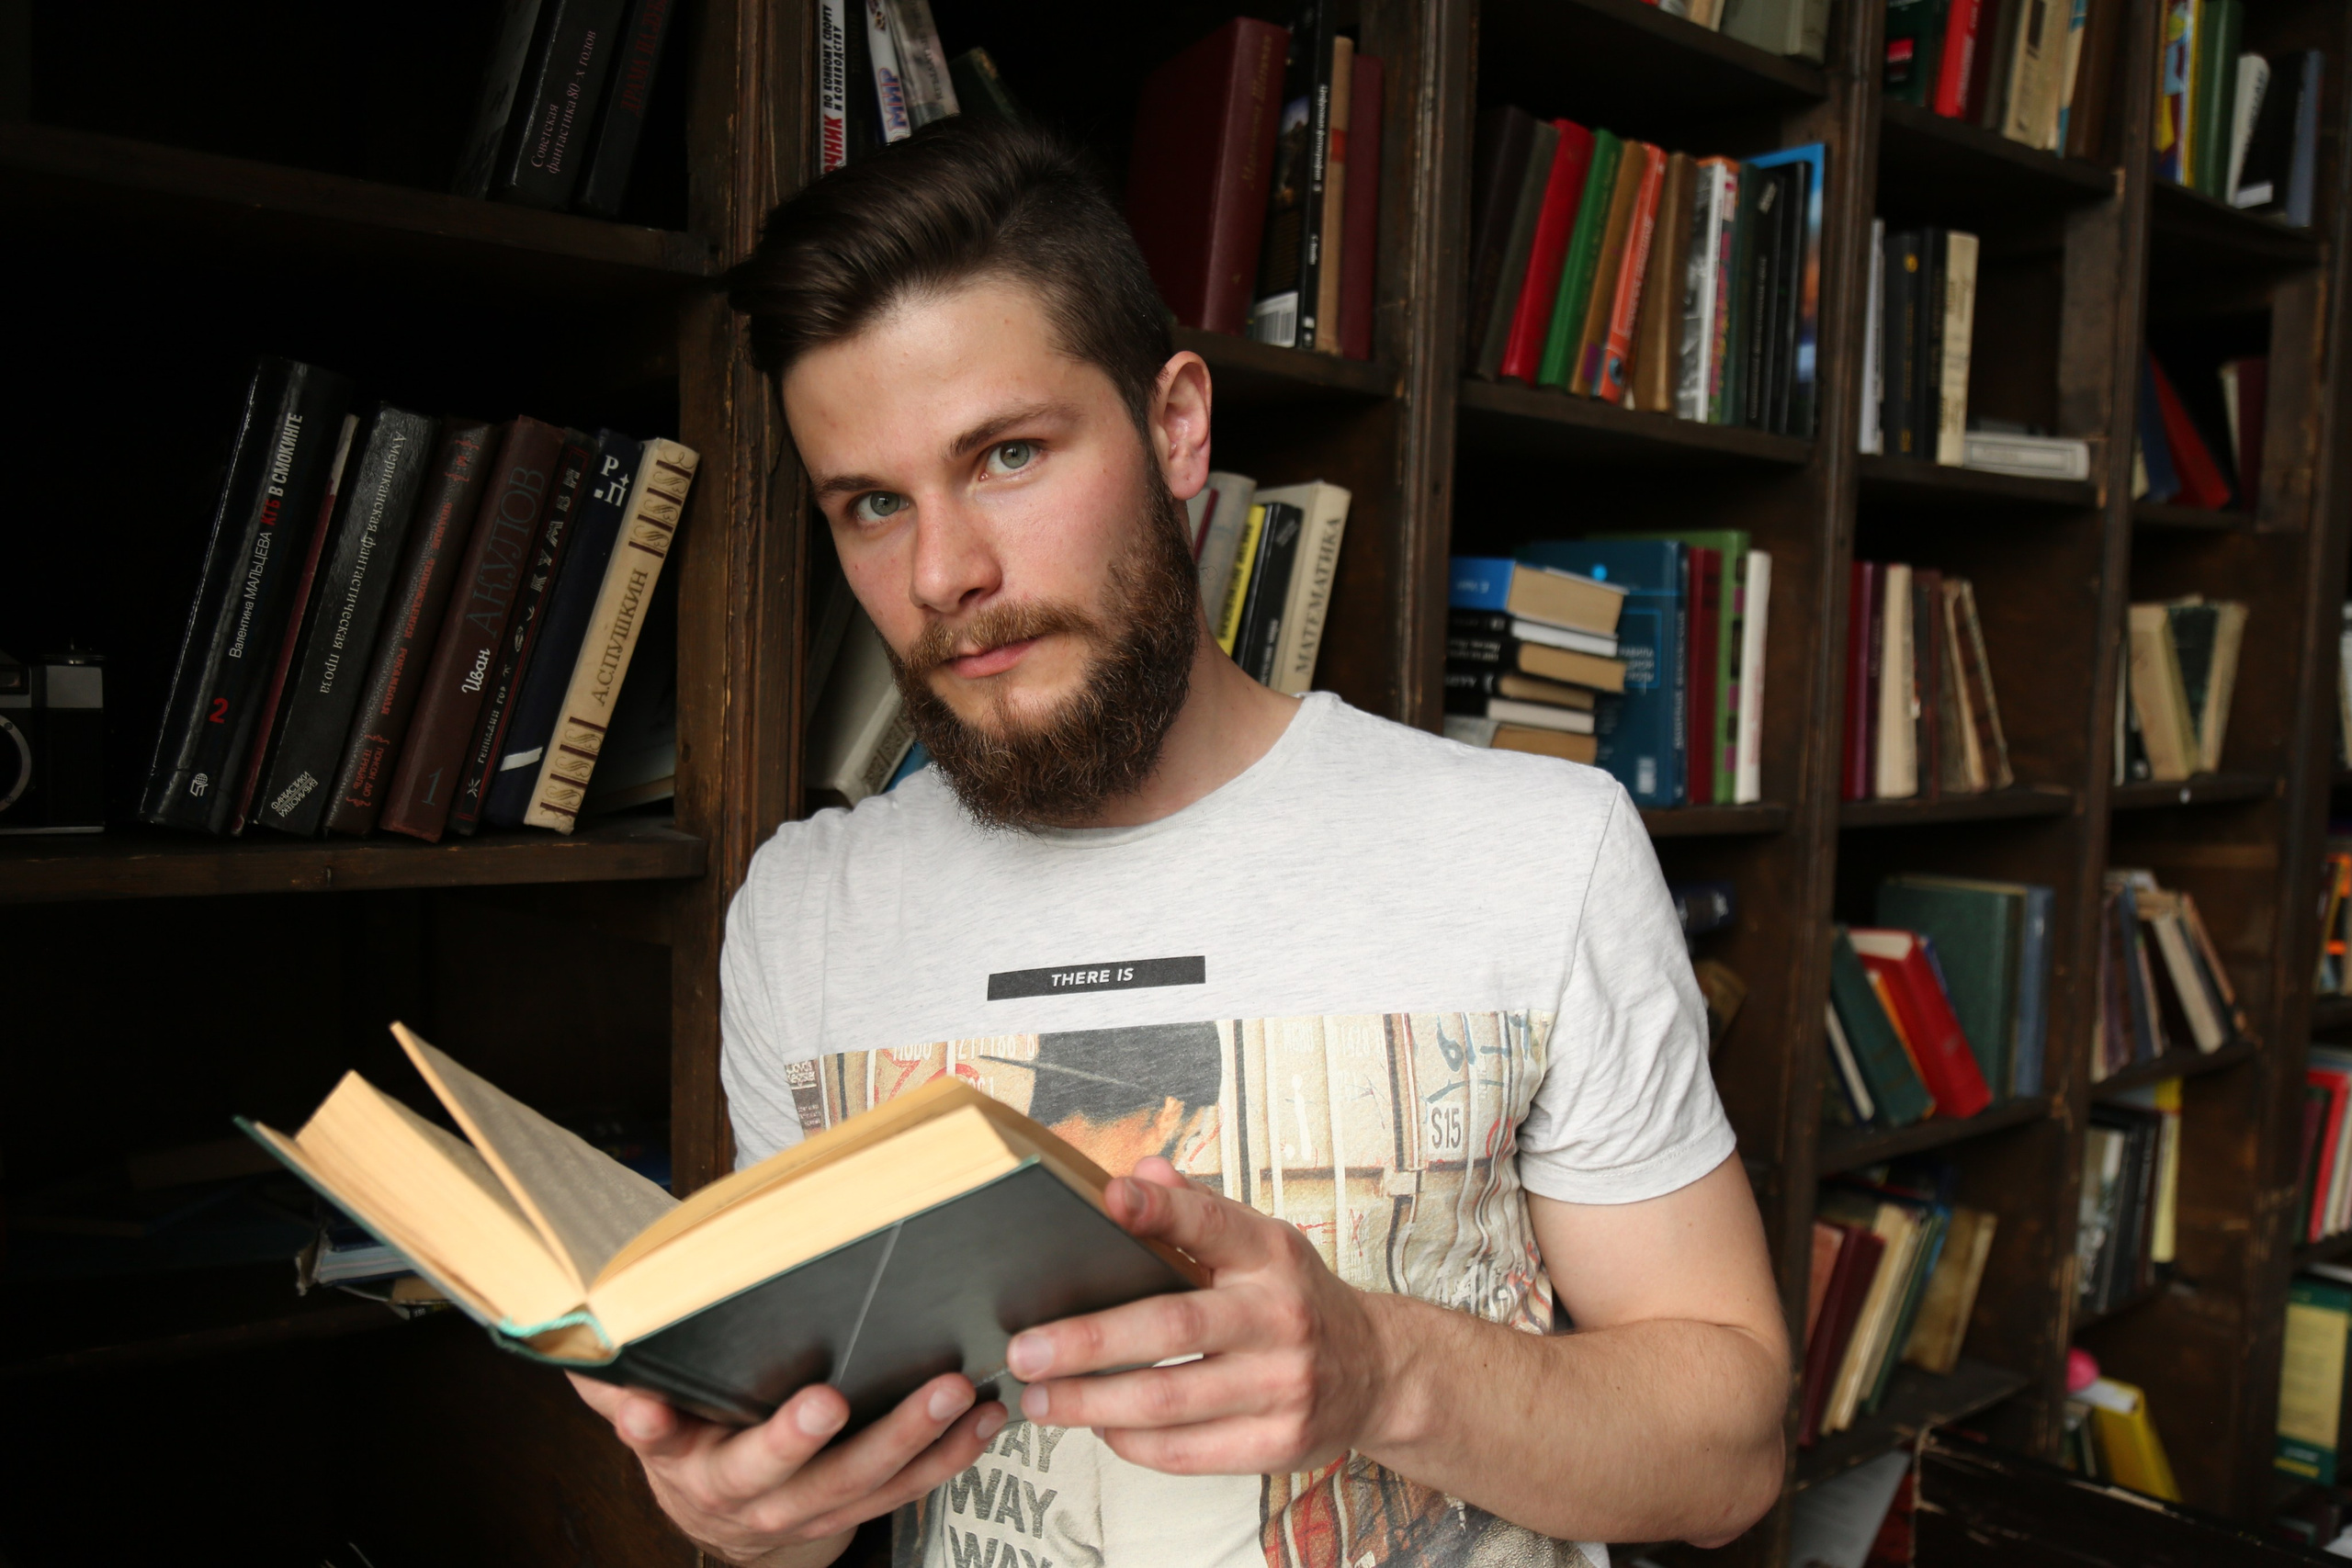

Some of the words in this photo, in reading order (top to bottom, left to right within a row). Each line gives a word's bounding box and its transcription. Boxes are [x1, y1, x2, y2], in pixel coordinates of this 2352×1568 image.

[822, 5, 832, 42] СПОРТУ
[823, 44, 833, 89] КОННОМУ
[833, 26, 844, 101] КОНЕВОДСТВУ
[547, 98, 577, 174] фантастика
[579, 30, 596, 66] годов
[823, 95, 832, 108] ПО
[877, 67, 908, 130] МИР
[531, 104, 559, 167] Советская
[824, 114, 842, 173] ЧНИК
[273, 412, 303, 484] СМОКИНГЕ
[269, 485, 284, 497] В
[367, 431, 407, 533] Американская
[260, 497, 281, 526] КГБ
[243, 532, 273, 602] МАЛЬЦЕВА
[466, 466, 547, 638] АКУЛОВ
[332, 534, 378, 649] фантастическая
[1295, 516, 1341, 675] МАТЕМАТИКА
[230, 602, 254, 659] Валентина
[320, 655, 340, 694] проза
[380, 647, 408, 715] РОКАМБОЛЯ
[461, 648, 492, 694] Иван
[209, 697, 229, 724] 2
[368, 747, 384, 781] ПОНСОН
[422, 767, 443, 807] 1
[1051, 970, 1110, 987] THERE
[1117, 967, 1134, 982] IS
[1431, 1107, 1461, 1149] S15
[982, 1422, 1069, 1472] AY
[949, 1466, 1057, 1539] WAY
